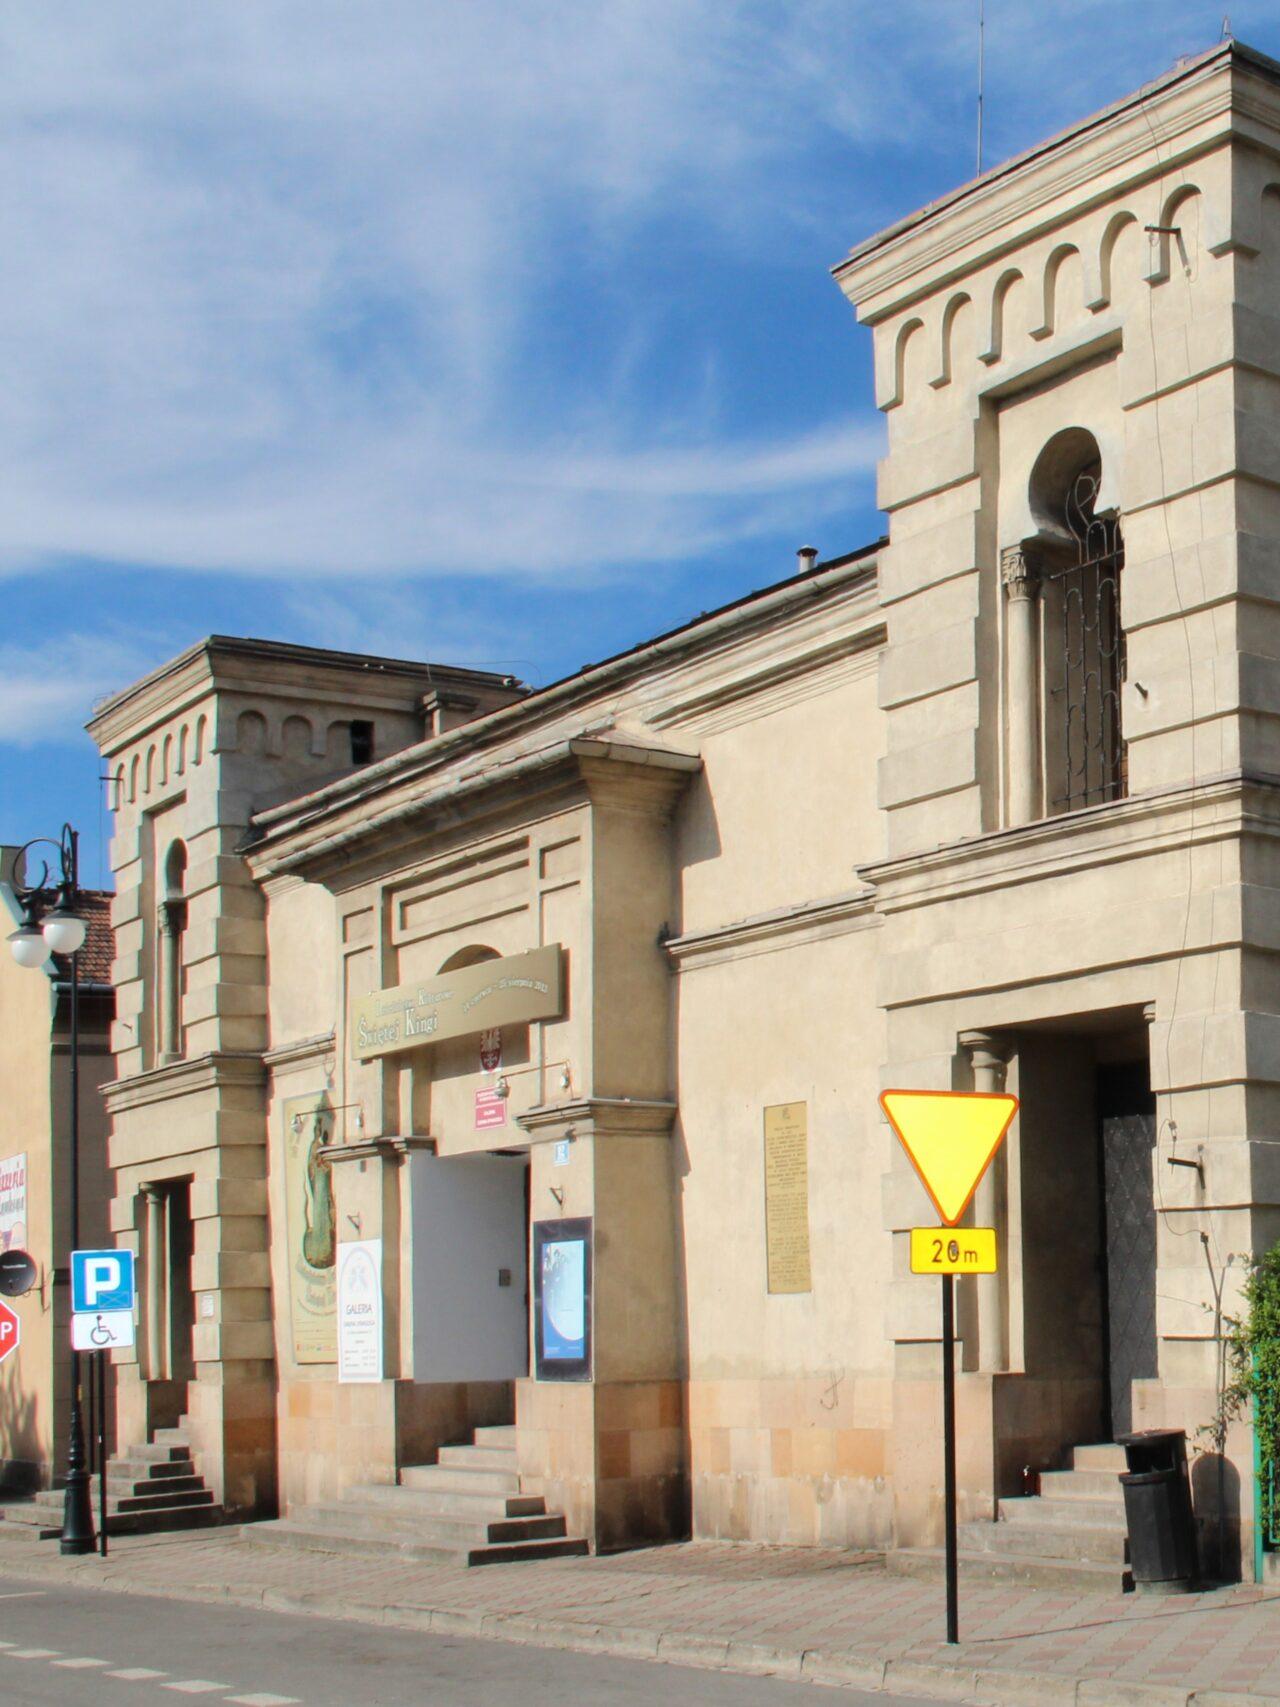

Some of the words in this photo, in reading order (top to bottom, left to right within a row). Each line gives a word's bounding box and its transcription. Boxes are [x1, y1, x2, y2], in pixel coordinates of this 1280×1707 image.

[405, 1008, 438, 1036] Kingi
[931, 1239, 960, 1264] 20
[963, 1249, 978, 1264] m
[84, 1257, 121, 1306] P
[346, 1303, 373, 1315] GALERIA
